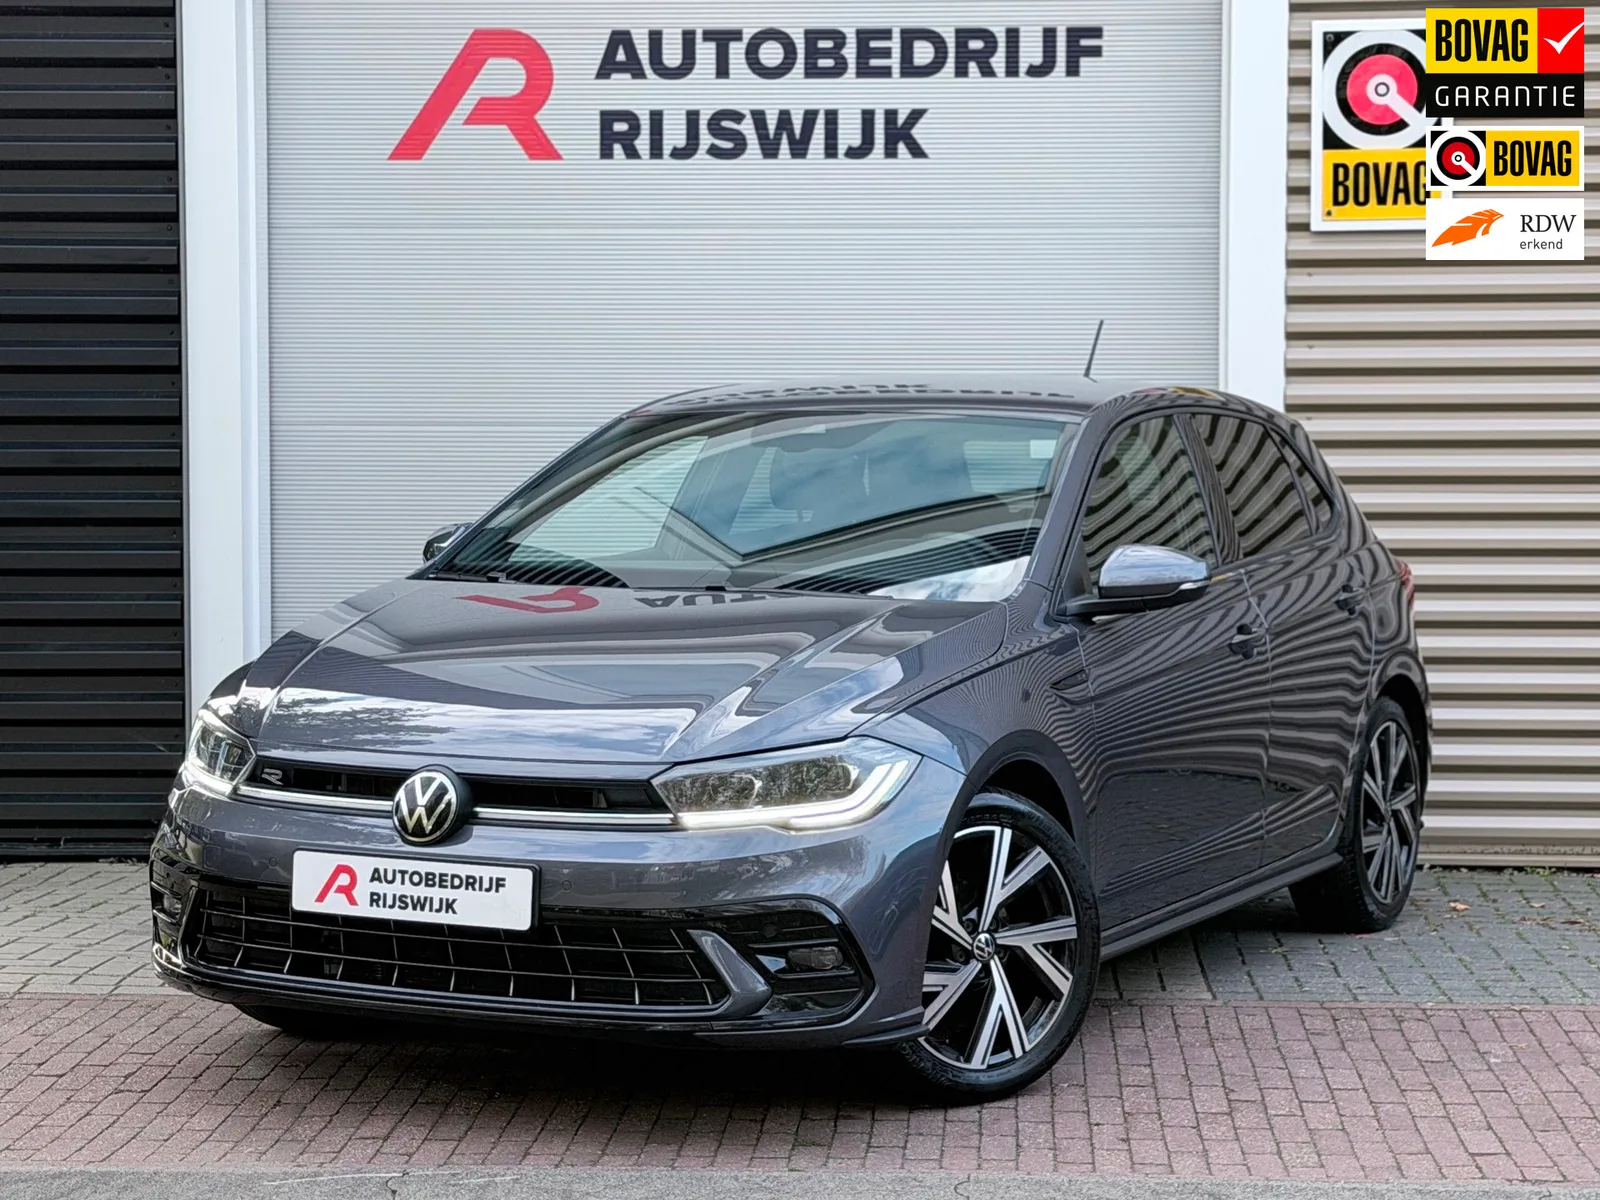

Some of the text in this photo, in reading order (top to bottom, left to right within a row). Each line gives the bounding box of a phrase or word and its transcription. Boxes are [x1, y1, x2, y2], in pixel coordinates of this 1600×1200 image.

[595, 27, 1103, 80] AUTOBEDRIJF
[599, 109, 930, 160] RIJSWIJK
[369, 867, 507, 893] AUTOBEDRIJF
[369, 891, 459, 915] RIJSWIJK
